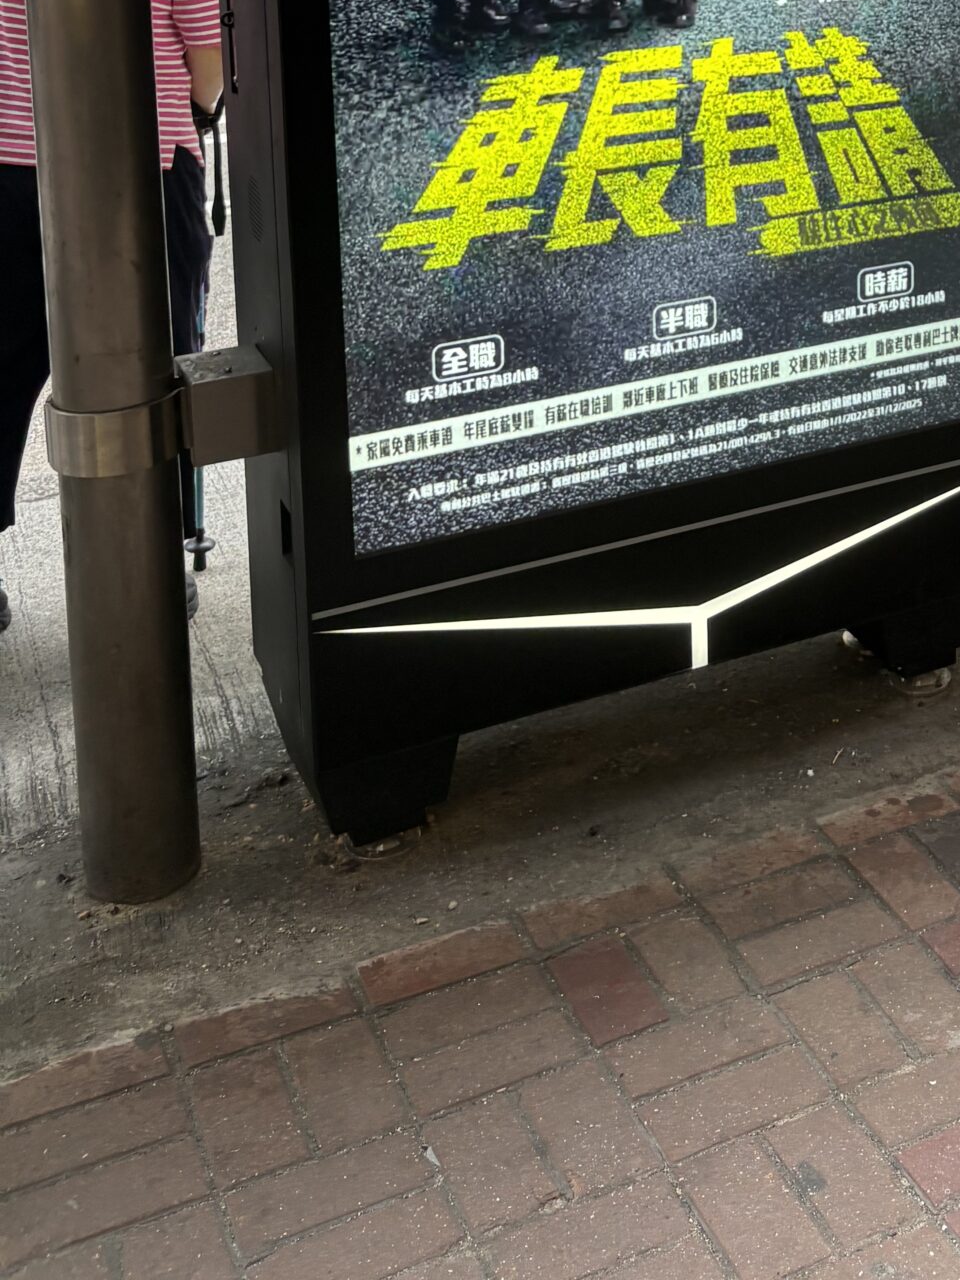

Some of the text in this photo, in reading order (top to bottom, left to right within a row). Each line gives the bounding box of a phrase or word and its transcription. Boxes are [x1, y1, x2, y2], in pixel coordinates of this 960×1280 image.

[372, 27, 957, 271] 車長有請
[863, 266, 910, 298] 時薪
[659, 301, 710, 334] 半職
[440, 340, 497, 377] 全職
[404, 365, 540, 404] 每天基本工時為8小時
